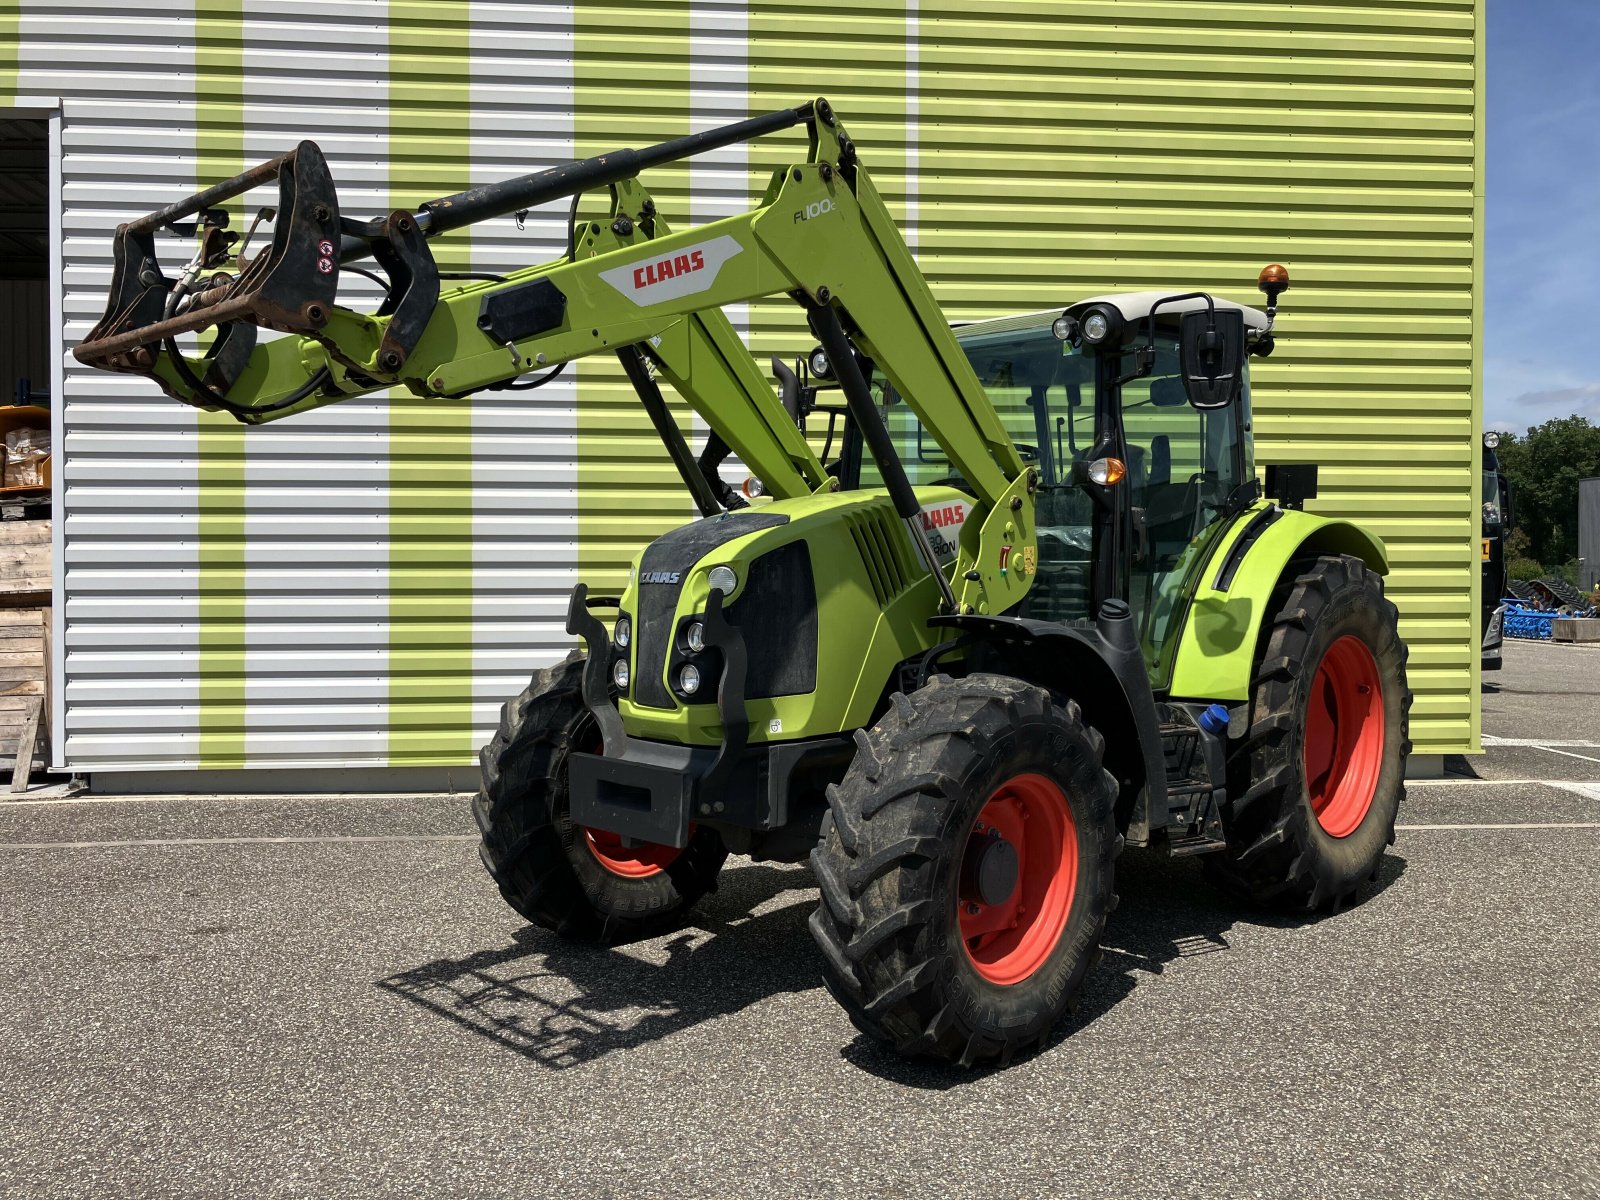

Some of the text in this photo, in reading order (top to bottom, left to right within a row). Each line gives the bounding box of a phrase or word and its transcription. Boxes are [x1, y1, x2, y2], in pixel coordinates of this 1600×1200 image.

[633, 250, 705, 289] CLAAS
[917, 505, 965, 532] LAAS
[932, 539, 956, 557] RION
[640, 571, 681, 585] CLAAS
[1044, 911, 1100, 1010] TRELLEBORG
